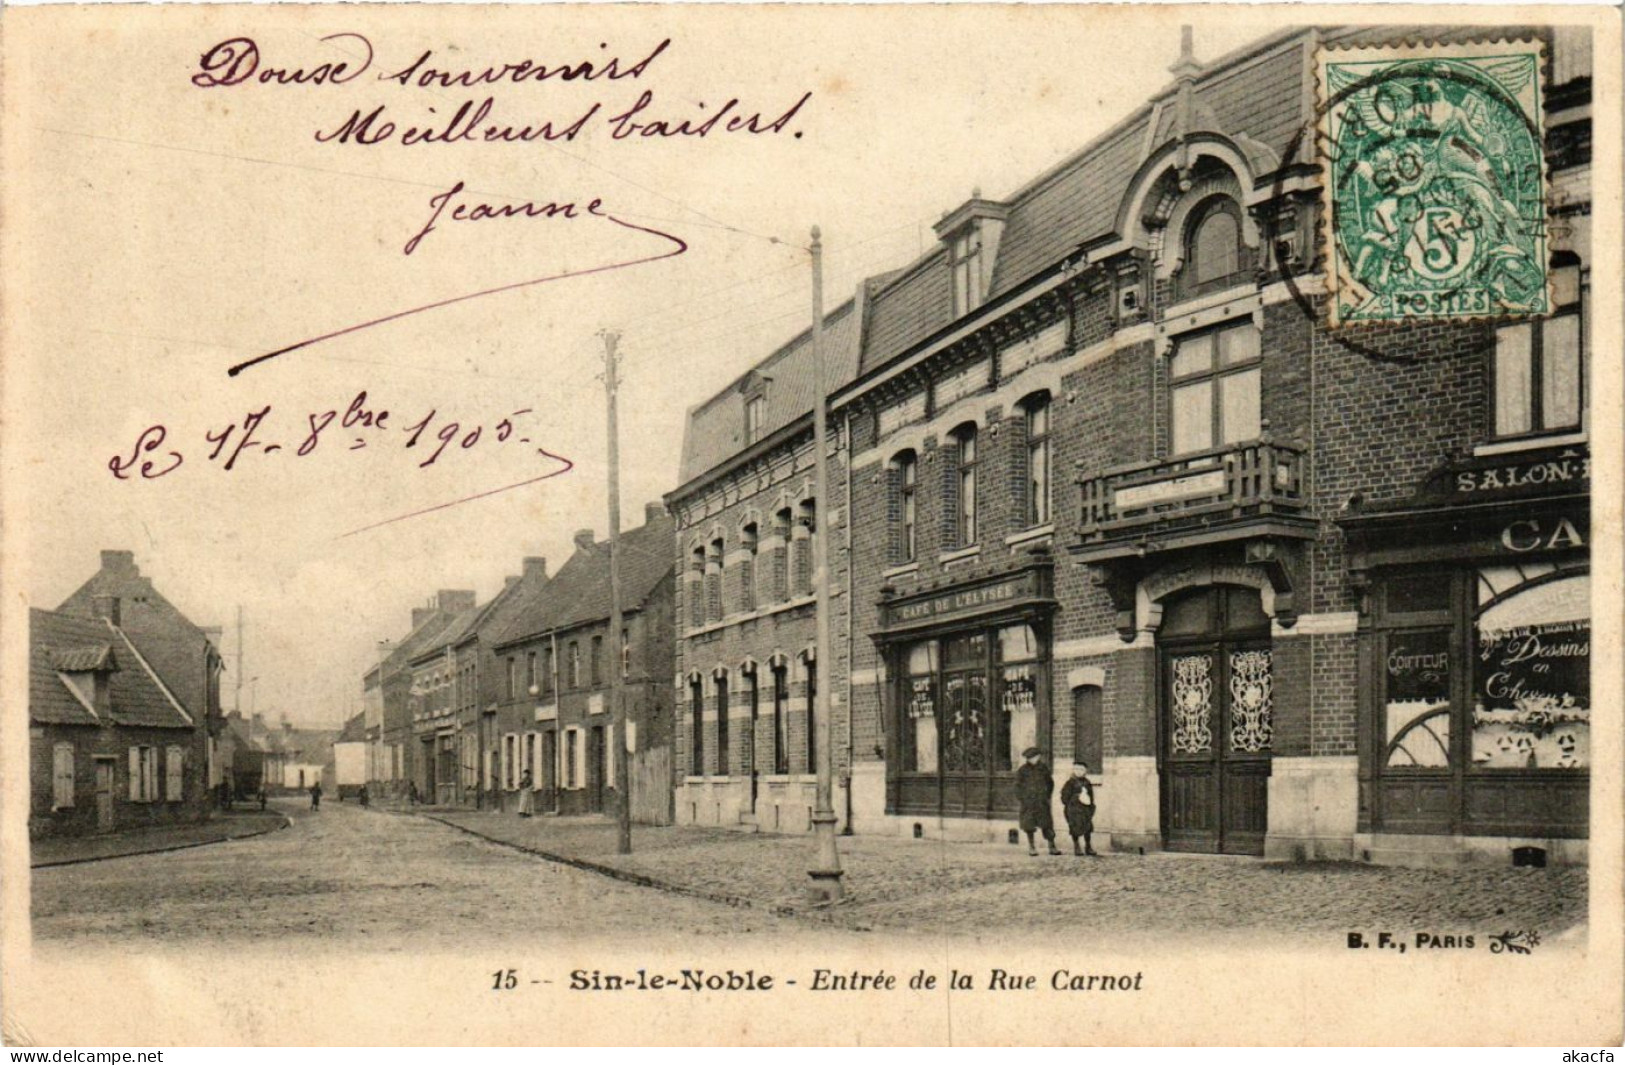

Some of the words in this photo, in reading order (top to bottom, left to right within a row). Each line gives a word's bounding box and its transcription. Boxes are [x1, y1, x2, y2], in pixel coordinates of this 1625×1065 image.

[314, 97, 602, 145] Meilleurs
[404, 181, 606, 256] Jeanne
[1396, 291, 1488, 315] POSTES
[491, 968, 519, 990] 15
[569, 968, 773, 991] Sin-le-Noble
[809, 968, 897, 991] Entrée
[908, 969, 937, 990] de
[949, 969, 973, 990] la
[987, 969, 1037, 990] Rue
[1050, 969, 1143, 991] Carnot
